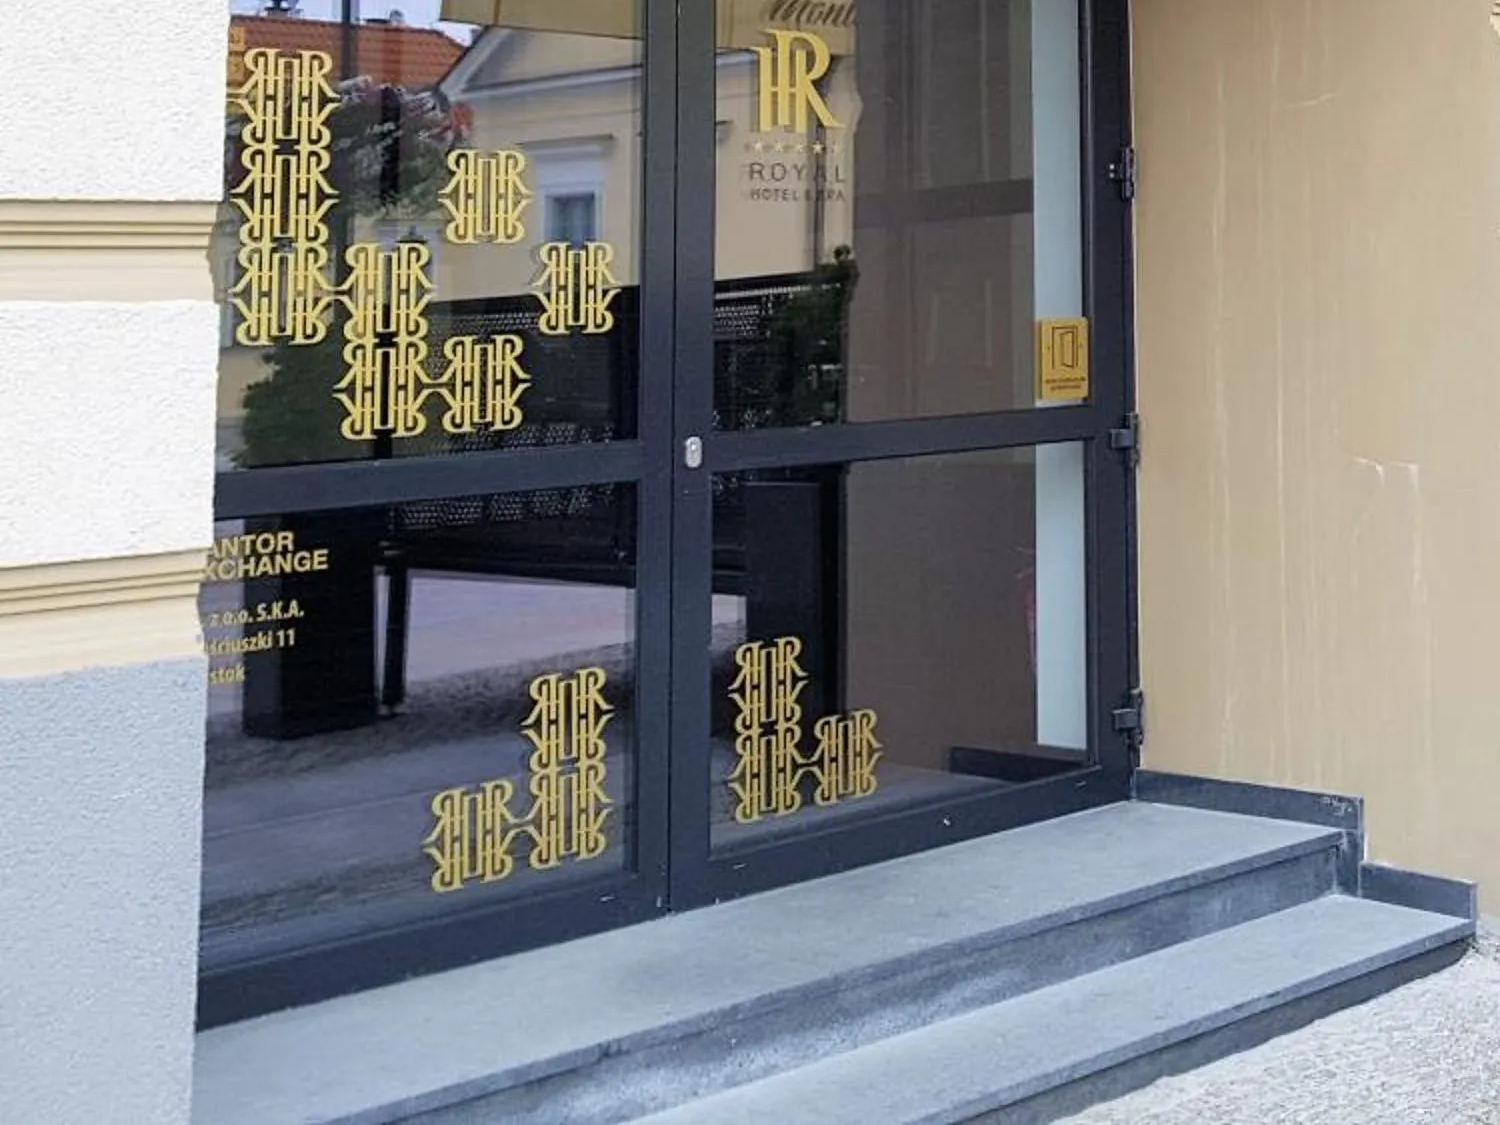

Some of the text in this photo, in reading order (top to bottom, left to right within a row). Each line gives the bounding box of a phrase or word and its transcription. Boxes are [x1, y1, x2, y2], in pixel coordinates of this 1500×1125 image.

[750, 162, 846, 183] ROYAL
[751, 188, 799, 201] HOTEL
[208, 532, 294, 559] ANTOR
[204, 549, 329, 580] XCHANGE
[256, 599, 305, 622] S.K.A.
[276, 627, 295, 647] 11
[209, 662, 245, 684] stok
